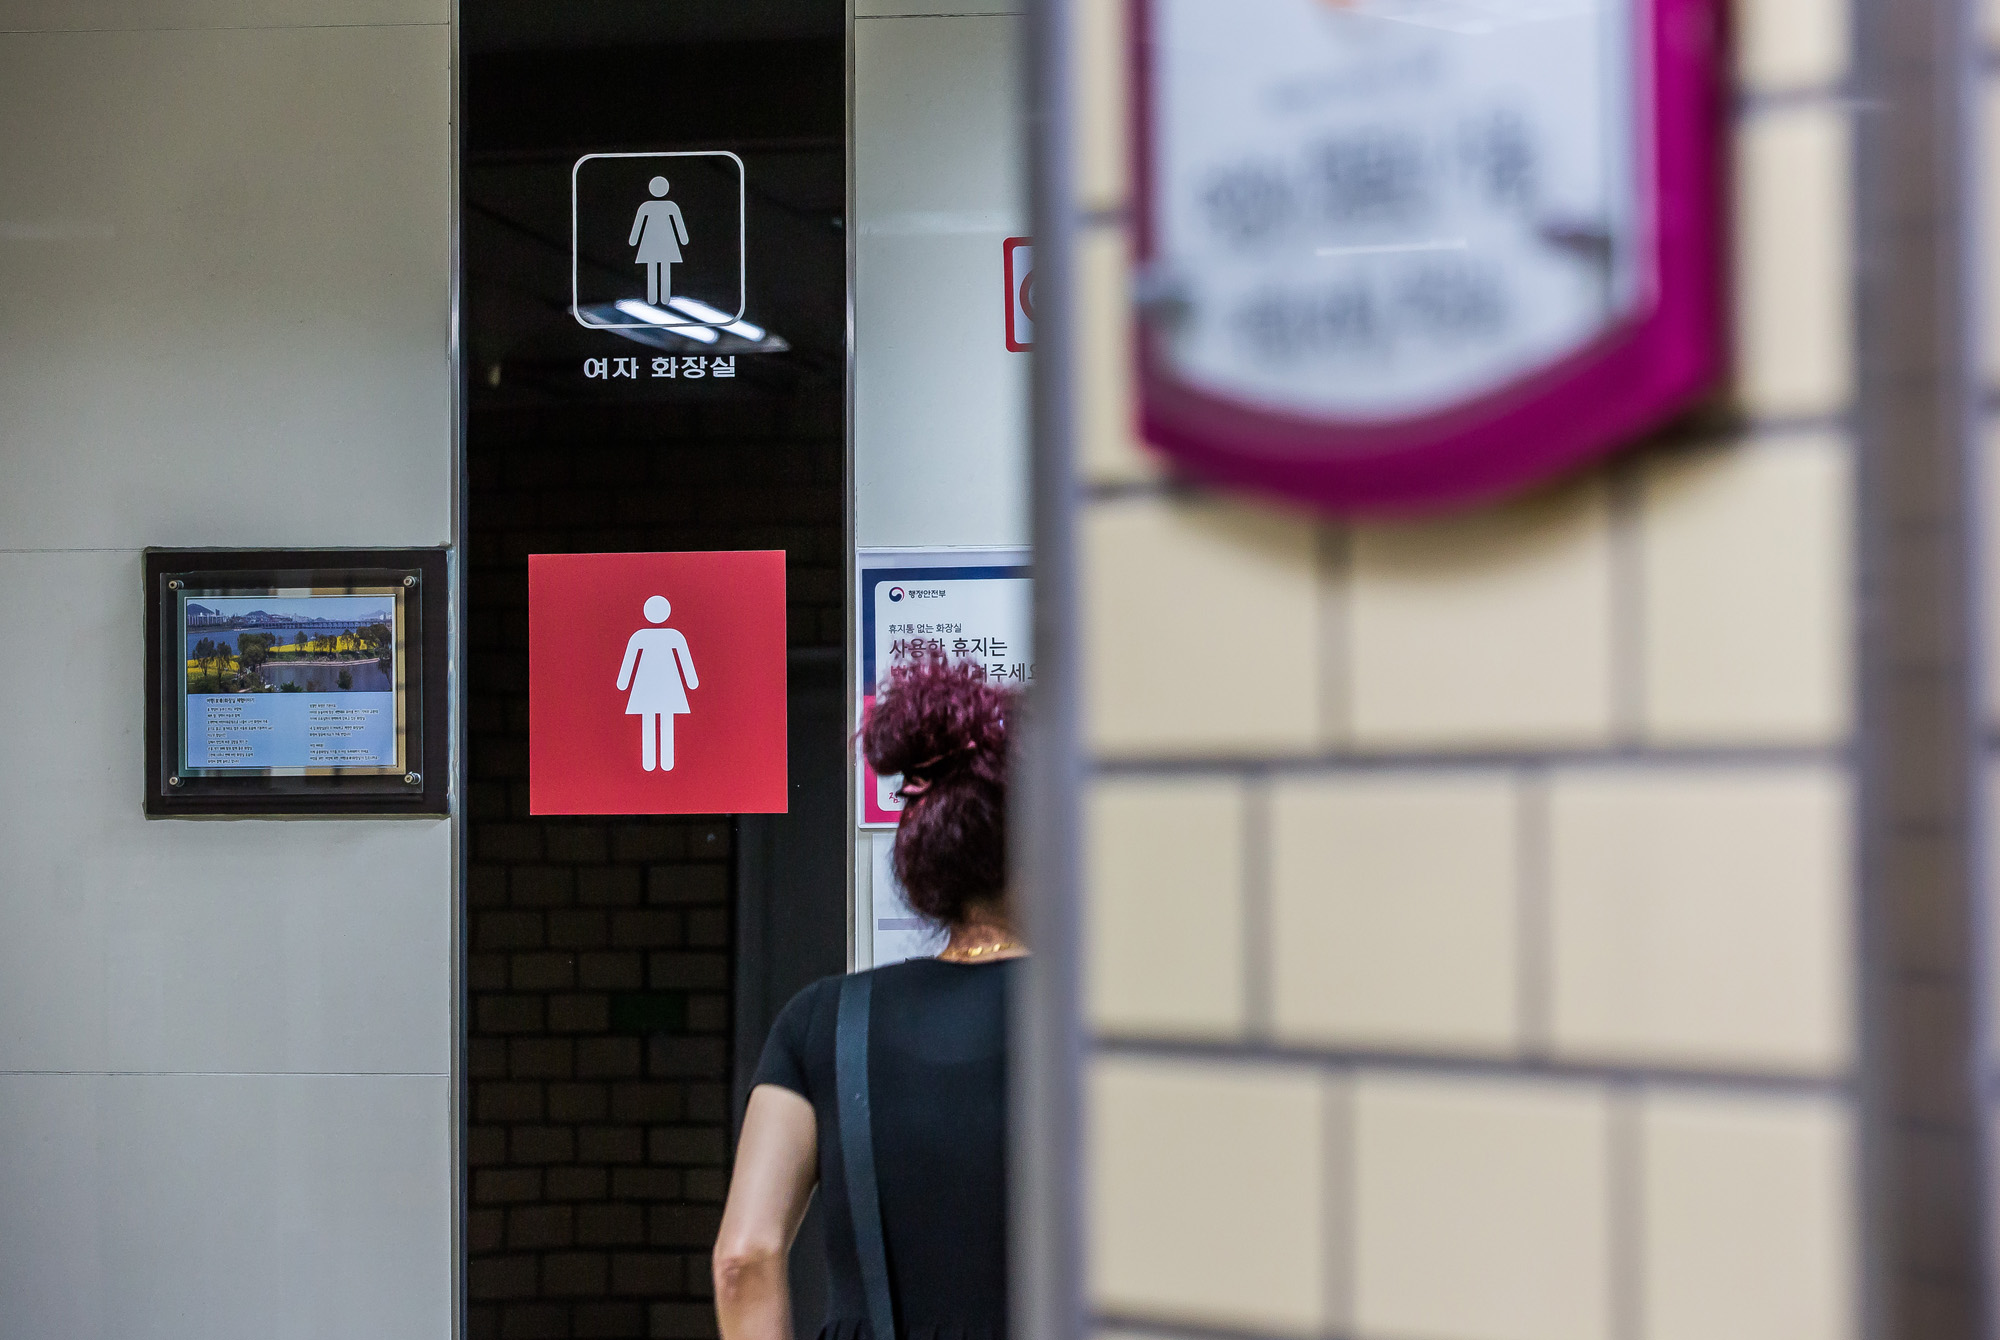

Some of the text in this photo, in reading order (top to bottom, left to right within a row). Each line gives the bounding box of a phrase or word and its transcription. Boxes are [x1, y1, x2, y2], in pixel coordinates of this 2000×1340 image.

[583, 355, 736, 379] 여자 화장실
[908, 589, 946, 599] 행정안전부
[888, 622, 962, 634] 휴지통 없는 화장실
[951, 637, 1008, 658] 휴지는
